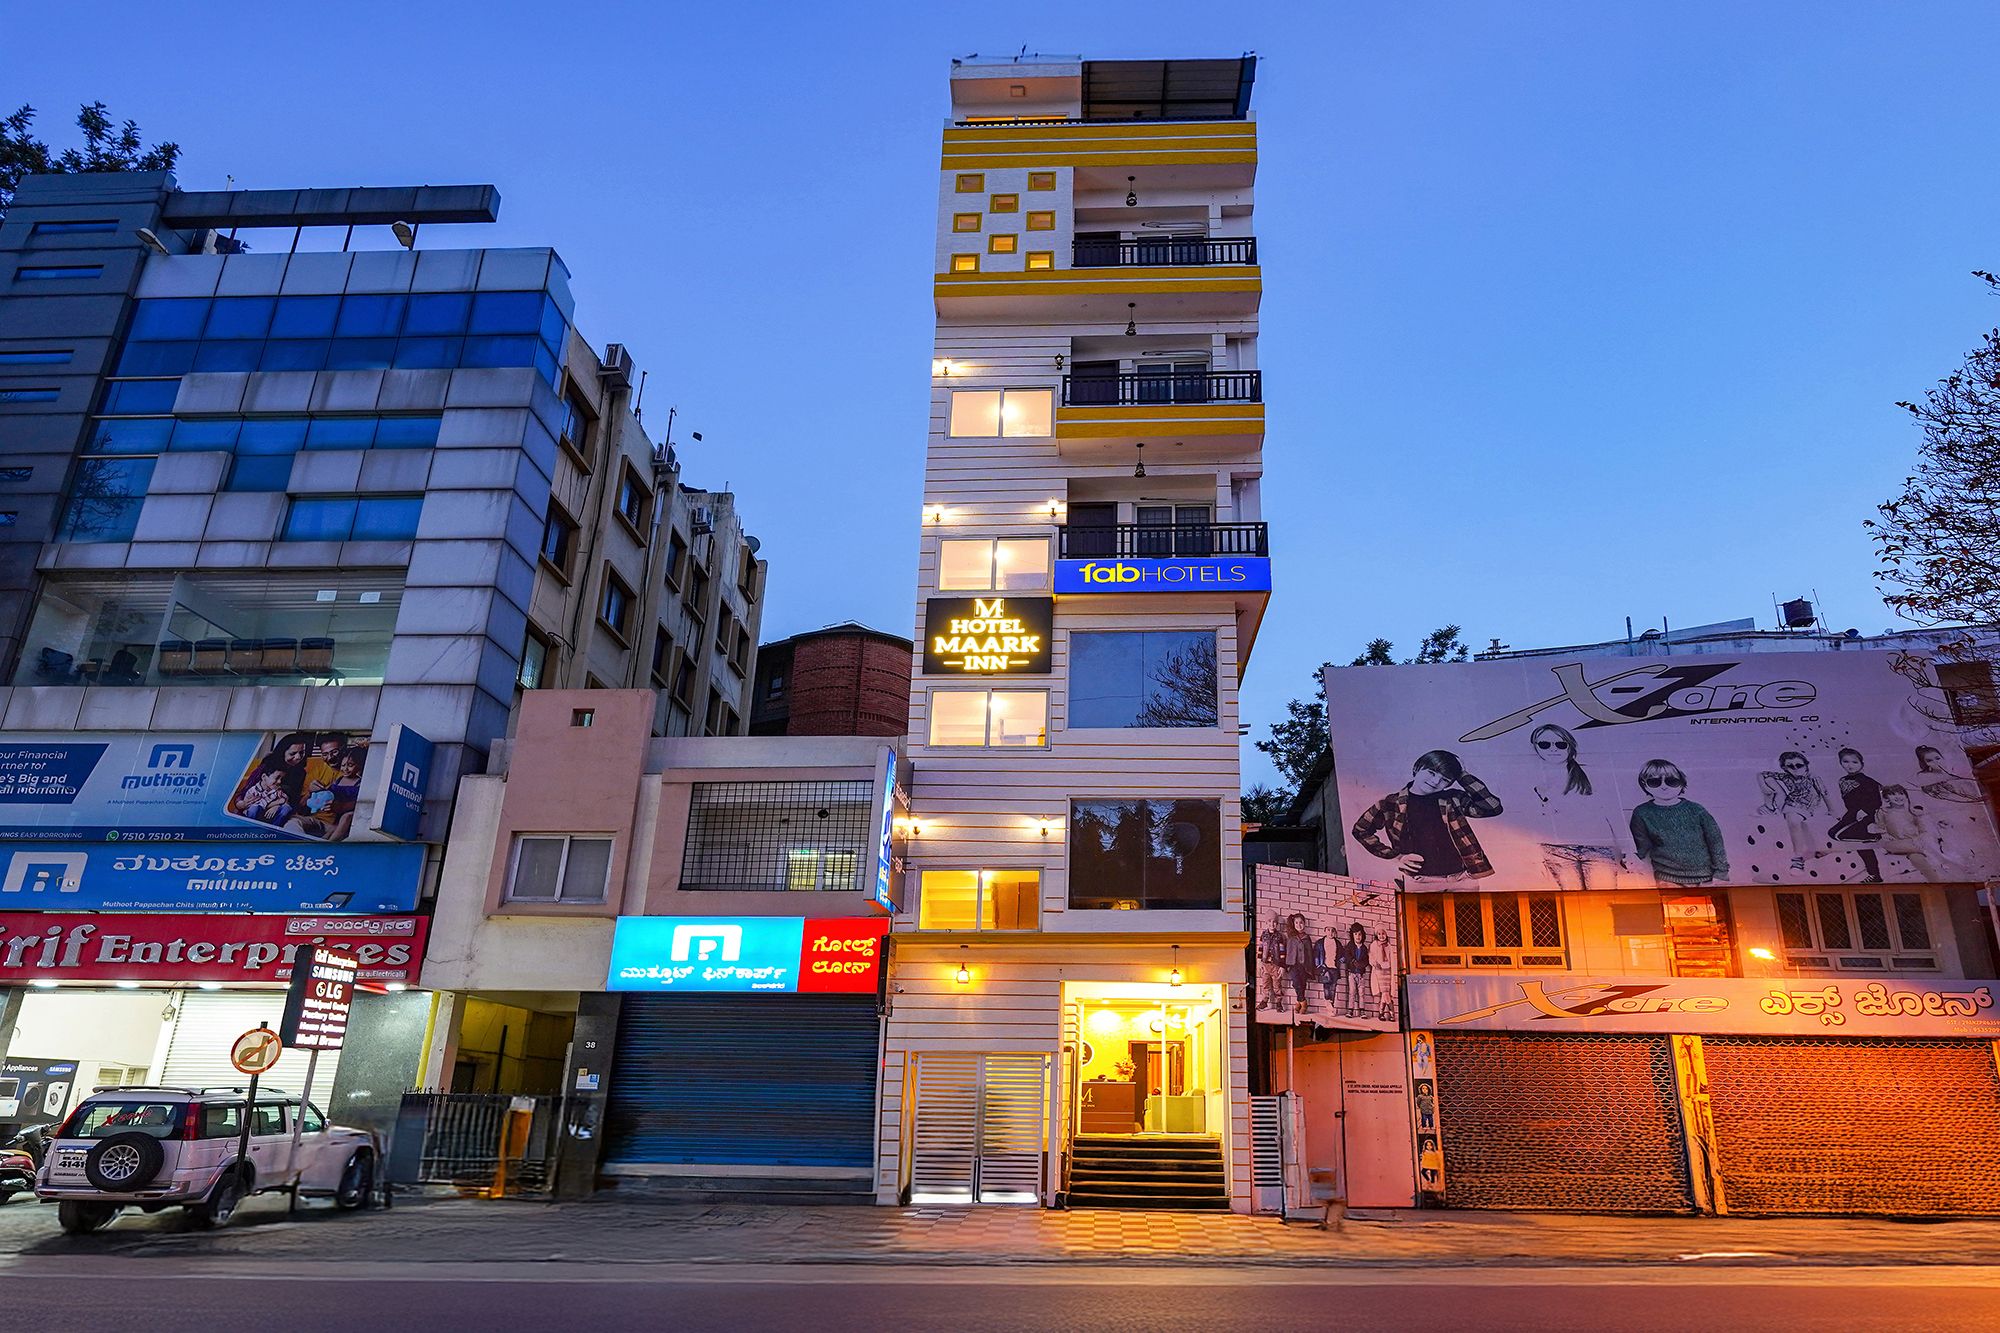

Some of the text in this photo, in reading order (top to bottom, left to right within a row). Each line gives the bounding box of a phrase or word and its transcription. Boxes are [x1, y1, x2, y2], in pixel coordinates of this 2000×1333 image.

[1079, 563, 1246, 583] fabHOTELS
[950, 619, 1026, 634] HOTEL
[934, 637, 1040, 653] MAARK
[963, 655, 1009, 670] INN
[1689, 715, 1820, 725] INTERNATIONAL CO
[18, 751, 68, 760] Financial
[18, 773, 40, 786] Big
[42, 773, 68, 784] and
[121, 772, 207, 790] muthoot
[20, 831, 38, 839] EASY
[39, 831, 83, 839] BORROWING
[122, 832, 185, 841] 7510 7510 21
[206, 832, 277, 840] muthootchits.com
[133, 901, 175, 909] Pappachan
[0, 924, 411, 970] rif Enterpres
[312, 965, 354, 983] SAMSUNG
[326, 982, 343, 999] LG
[1759, 985, 1847, 1026] ಎಕ್ಸ್
[585, 1041, 597, 1049] 38
[6, 1064, 39, 1072] Appliances
